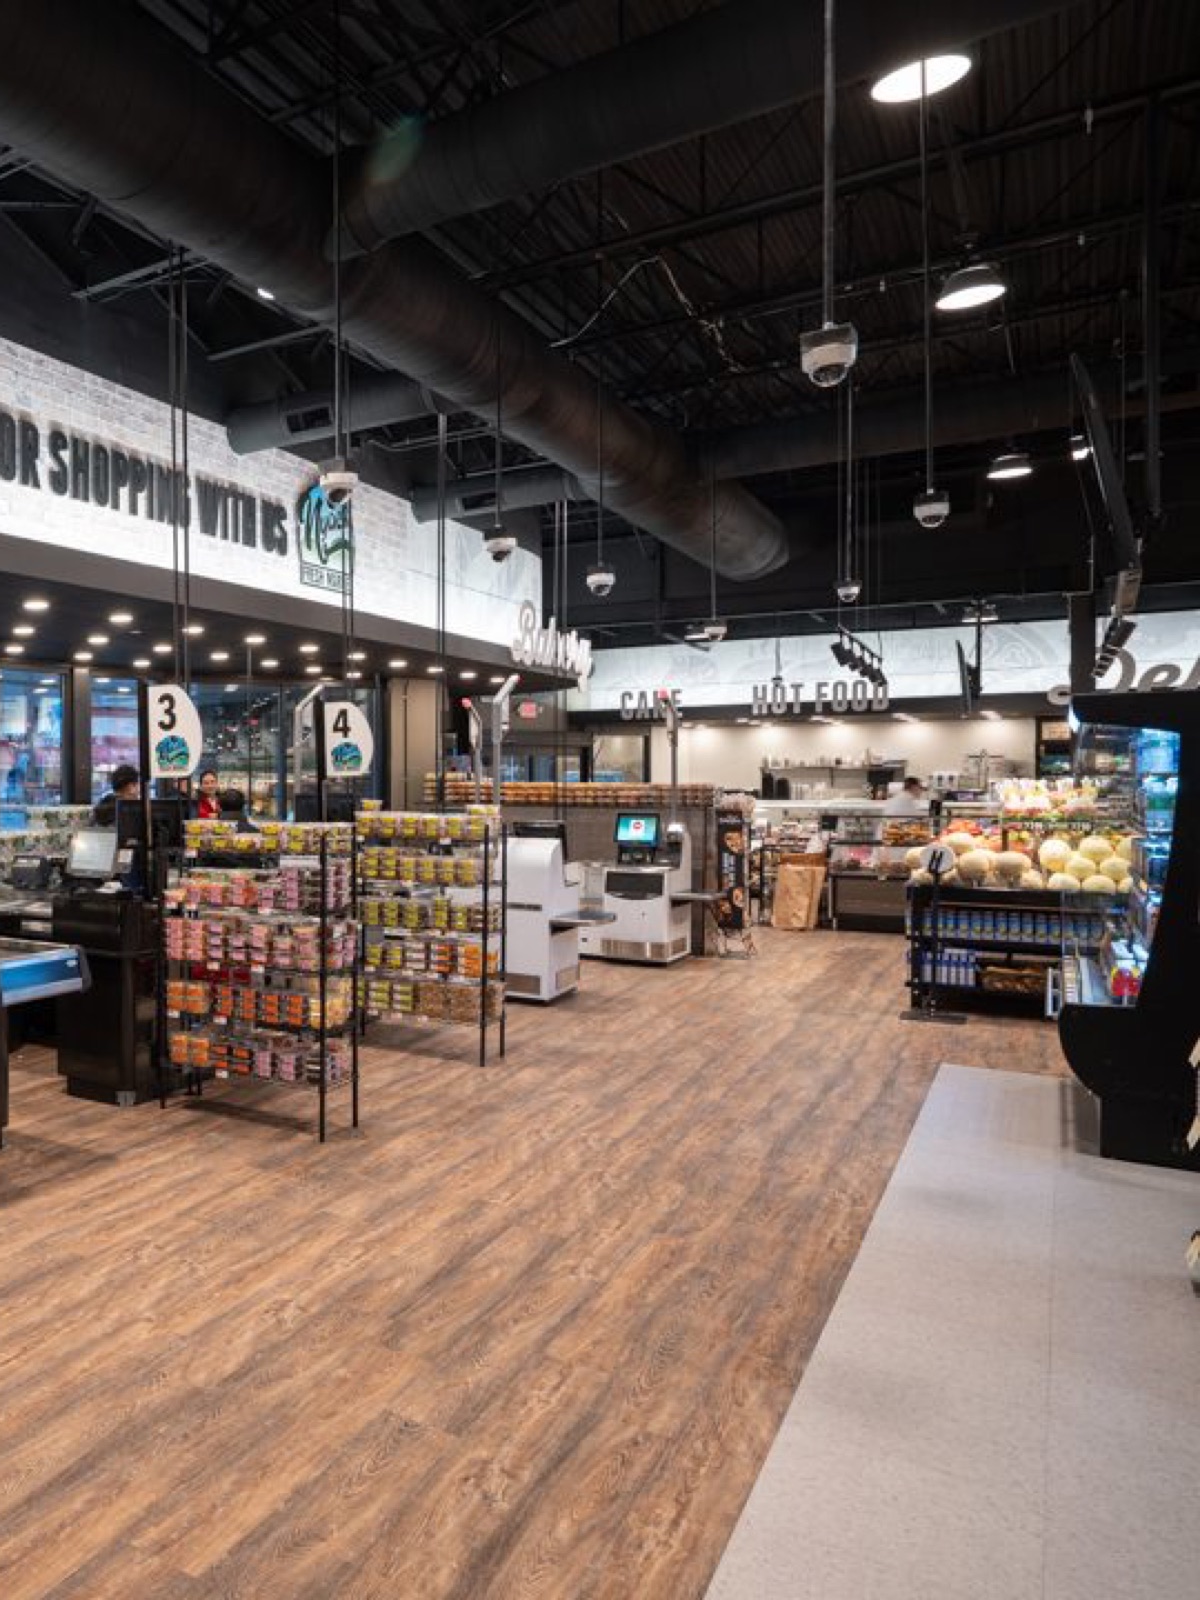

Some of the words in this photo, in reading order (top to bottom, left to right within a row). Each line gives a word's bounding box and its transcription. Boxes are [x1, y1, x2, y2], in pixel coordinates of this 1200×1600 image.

[48, 429, 191, 528] SHOPPING
[195, 476, 256, 548] WITH
[261, 498, 288, 556] US
[157, 692, 177, 732] 3
[753, 682, 804, 716] HOT
[815, 680, 890, 713] FOOD
[332, 708, 351, 738] 4
